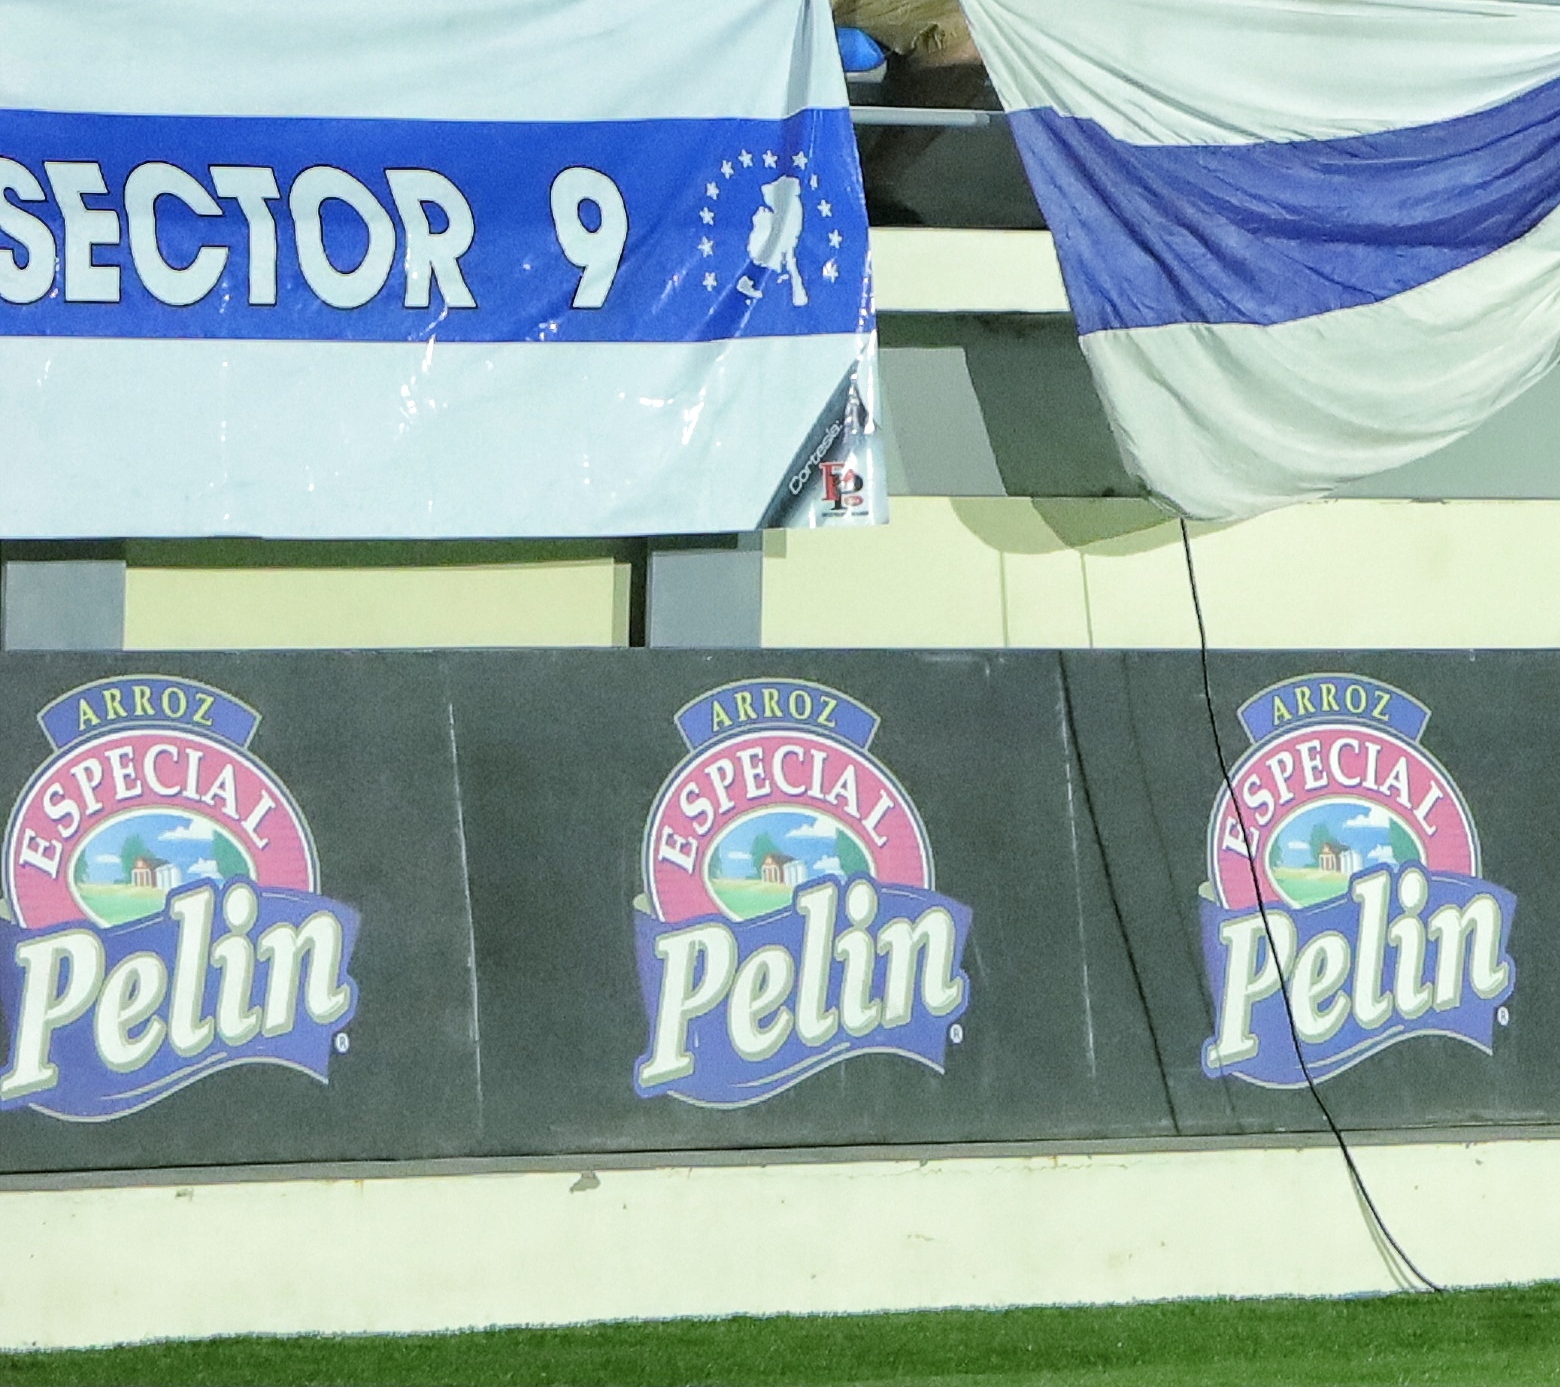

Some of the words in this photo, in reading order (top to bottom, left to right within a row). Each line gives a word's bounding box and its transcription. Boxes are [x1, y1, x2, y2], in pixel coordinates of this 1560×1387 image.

[0, 157, 477, 309] SECTOR
[550, 165, 629, 309] 9
[76, 684, 214, 730] ARROZ
[711, 684, 837, 729] ARROZ
[1271, 682, 1391, 724] ARROZ
[19, 743, 278, 879] ESPECIAL
[656, 744, 890, 872] ESPECIAL
[1220, 737, 1441, 861] ESPECIAL
[0, 884, 352, 1102] Pelin
[642, 885, 961, 1093] Pelin
[1206, 869, 1509, 1070] Pelin
